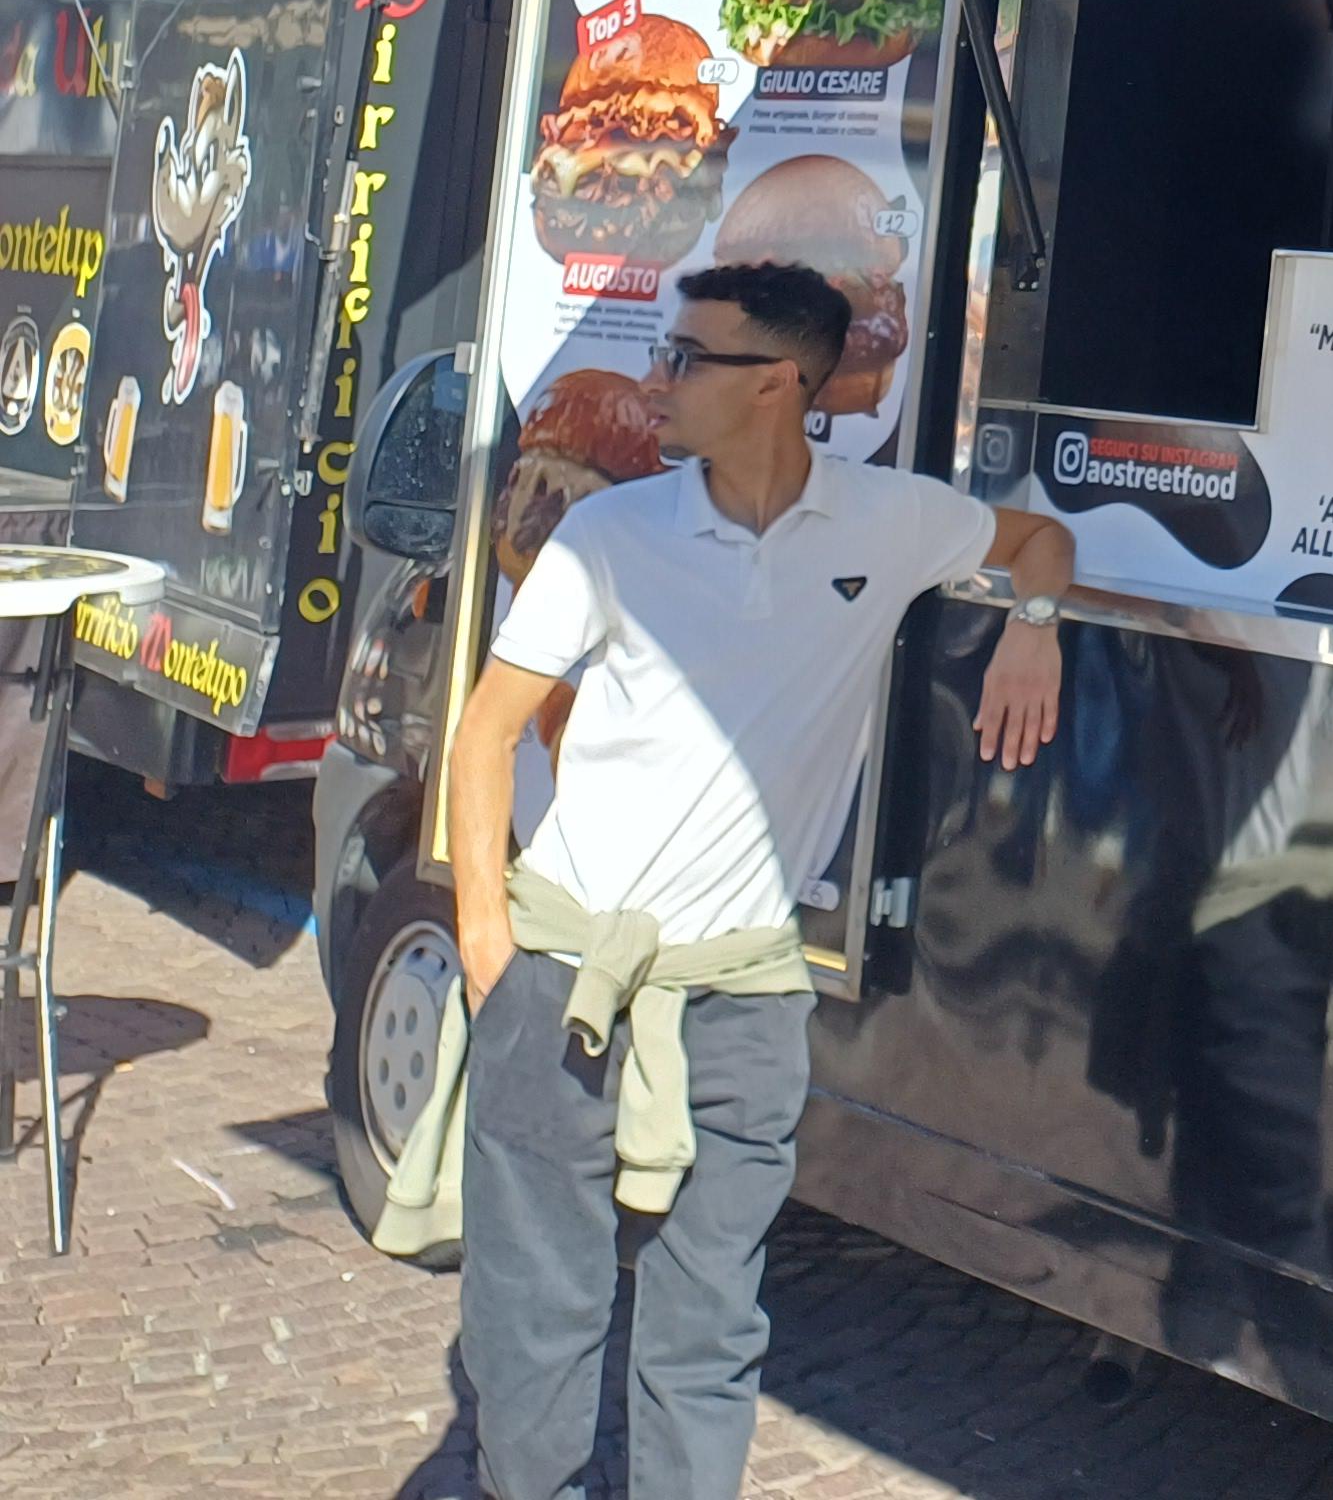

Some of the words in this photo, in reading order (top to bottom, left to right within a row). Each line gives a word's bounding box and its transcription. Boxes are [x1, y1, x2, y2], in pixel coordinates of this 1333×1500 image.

[585, 15, 619, 44] Top
[759, 70, 815, 93] GIULIO
[816, 70, 883, 94] CESARE
[564, 261, 657, 294] AUGUSTO
[1087, 460, 1237, 500] aostreetfood
